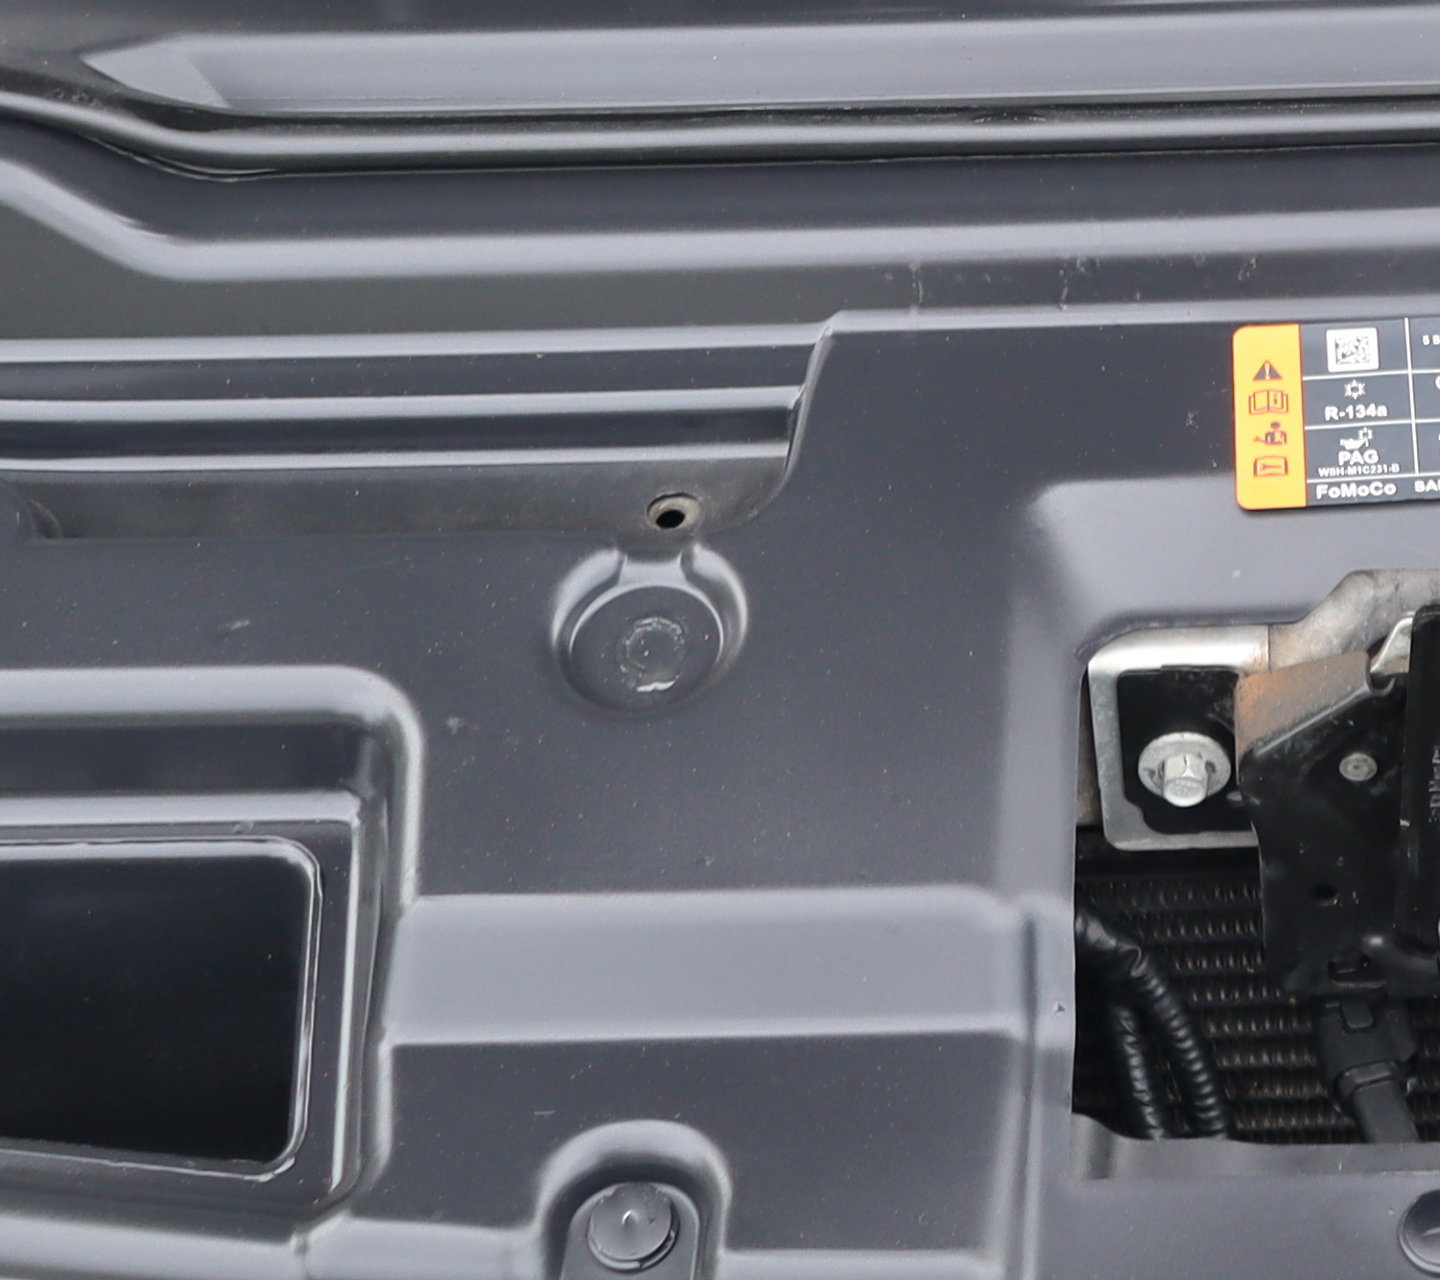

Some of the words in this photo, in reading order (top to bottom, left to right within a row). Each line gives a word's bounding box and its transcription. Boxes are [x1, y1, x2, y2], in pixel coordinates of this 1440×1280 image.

[1325, 404, 1388, 420] R-134a
[1338, 450, 1379, 465] PAG
[1316, 482, 1397, 499] FoMoCo
